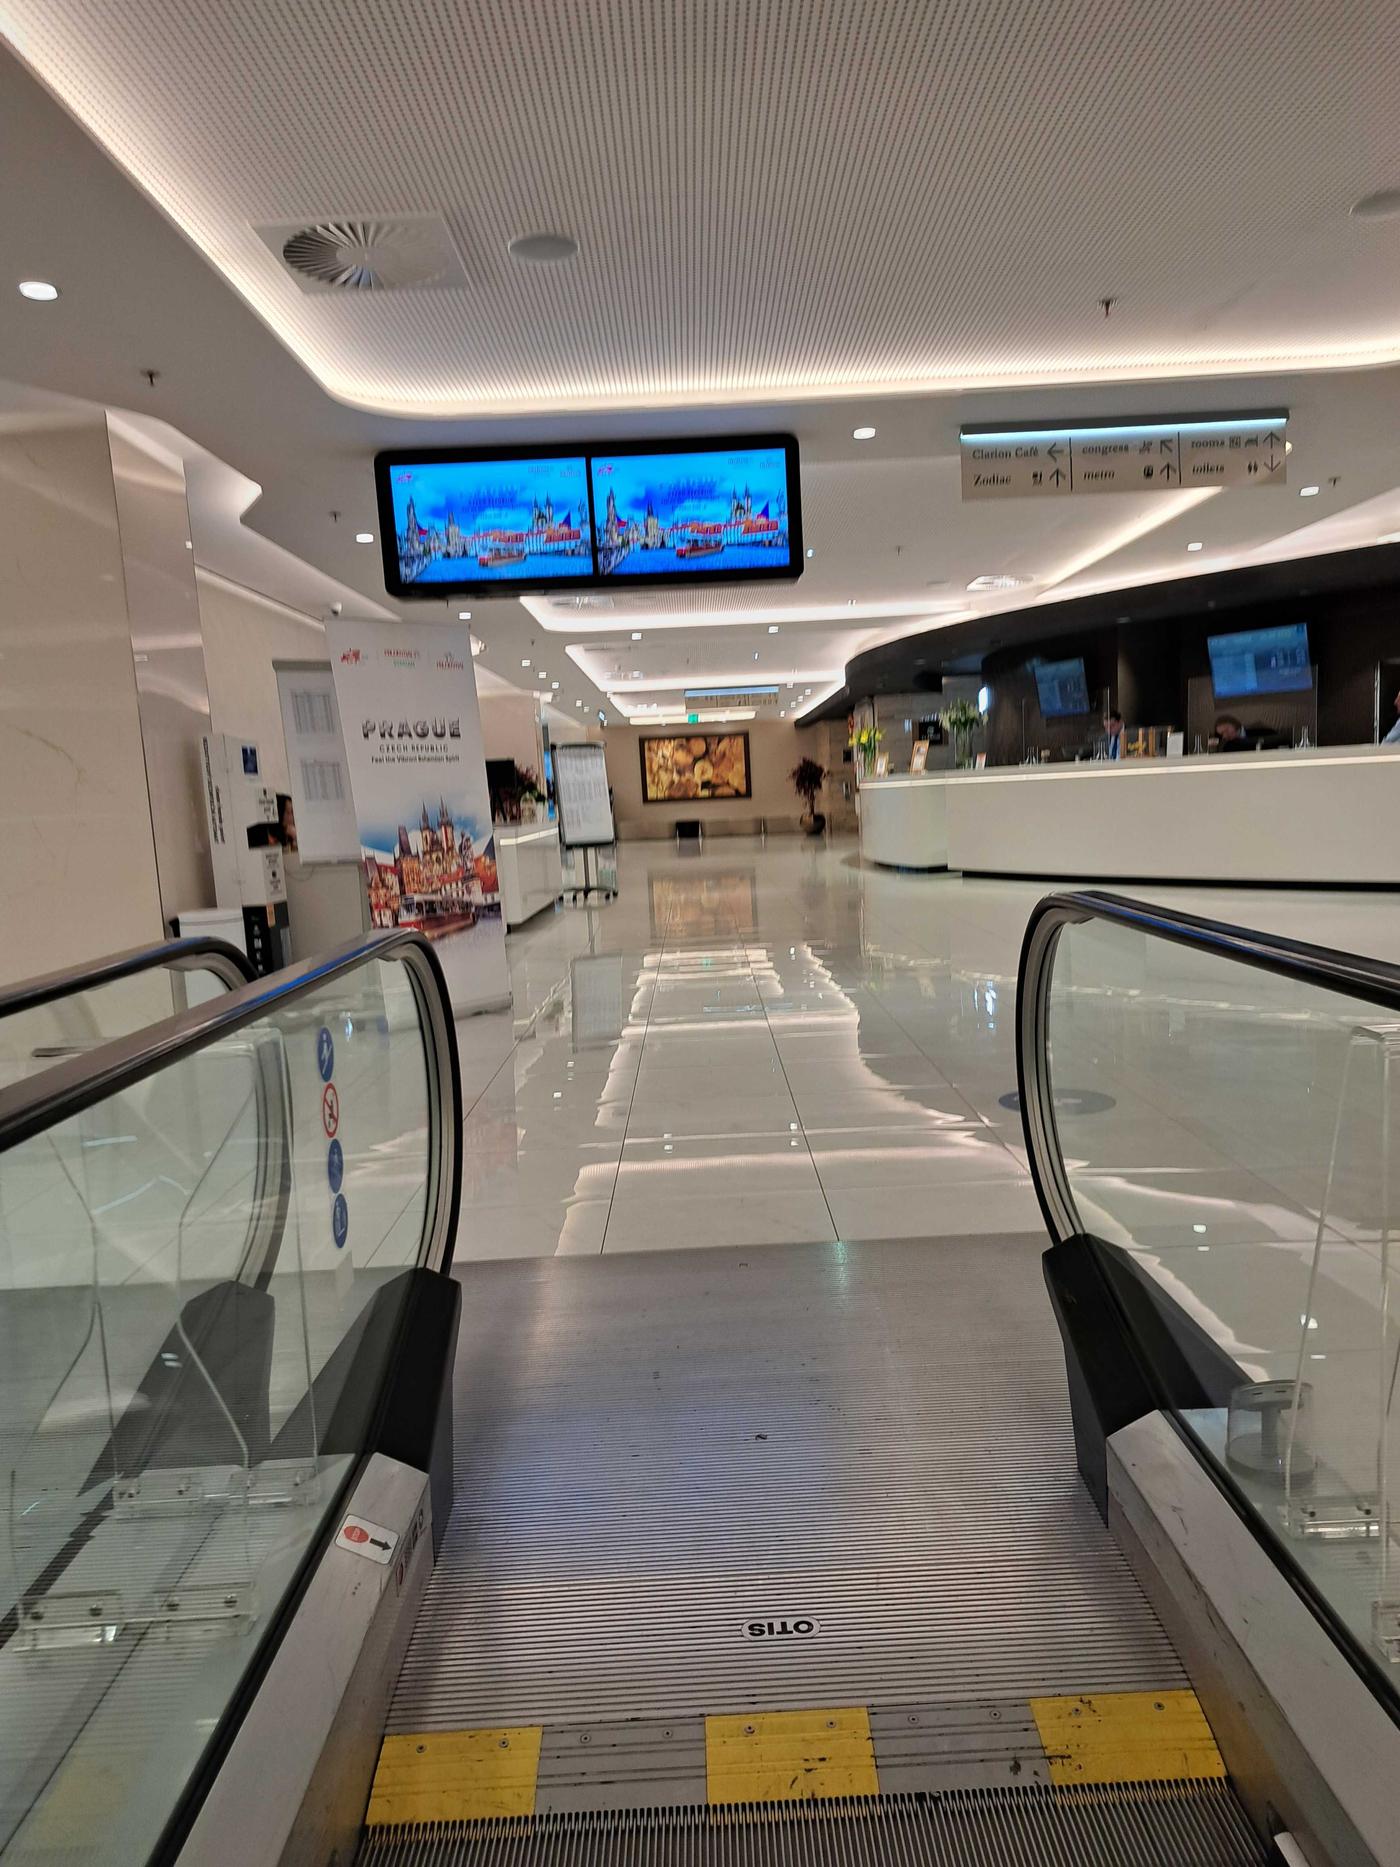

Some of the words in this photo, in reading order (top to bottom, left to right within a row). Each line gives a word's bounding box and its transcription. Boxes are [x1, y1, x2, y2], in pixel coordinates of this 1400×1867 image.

[1082, 444, 1129, 456] congress
[1191, 439, 1225, 449] rooms
[972, 448, 1011, 459] Clarion
[1015, 446, 1038, 457] Café
[1192, 463, 1225, 474] toilets
[973, 473, 1012, 486] Zodiac
[1083, 470, 1115, 480] metro
[362, 718, 461, 739] PRAGUE
[379, 744, 408, 753] CZECH
[411, 744, 449, 753] REPUBLIC
[748, 1620, 814, 1637] OTIS
